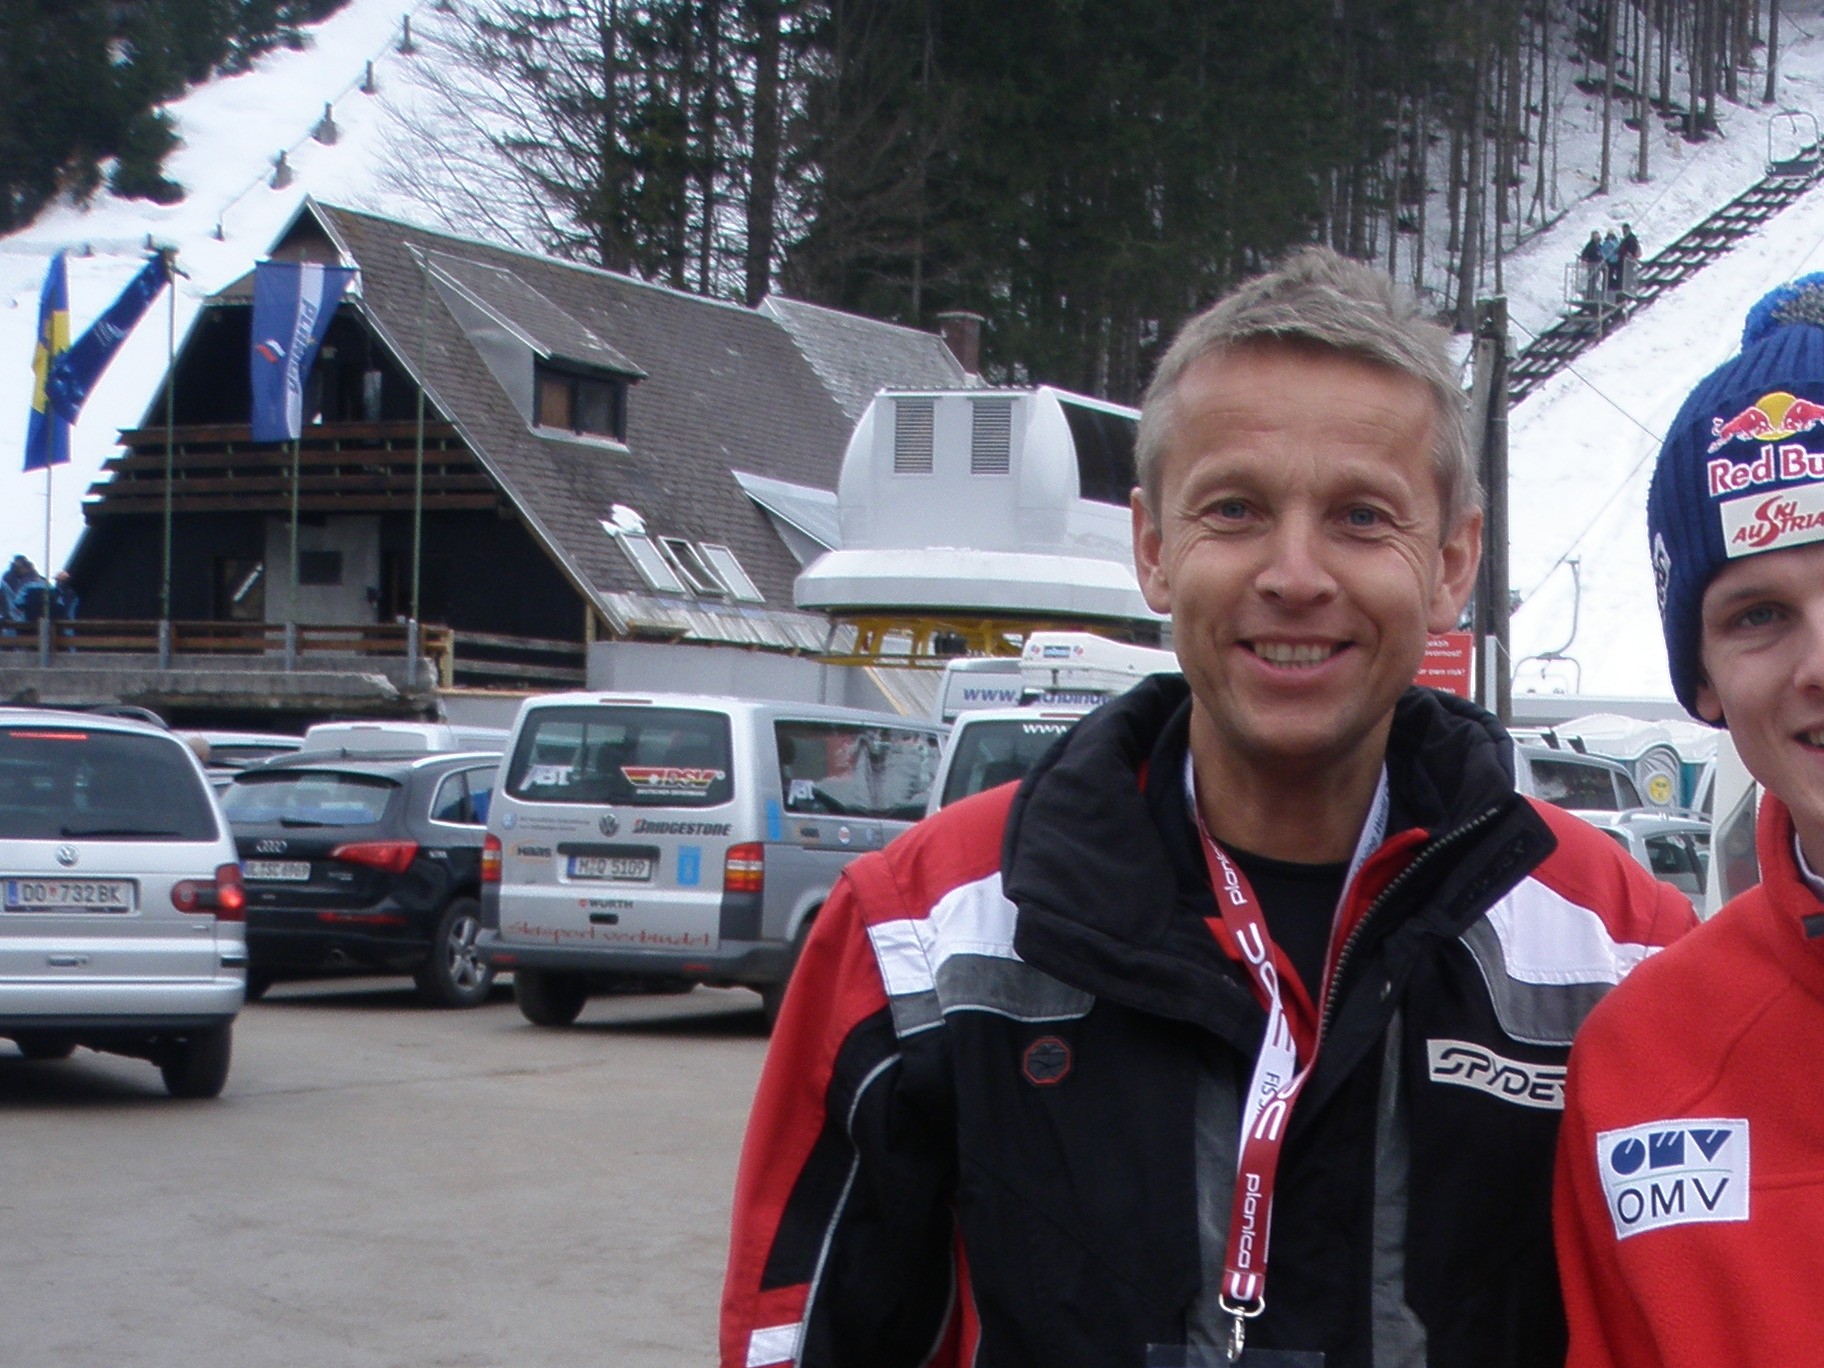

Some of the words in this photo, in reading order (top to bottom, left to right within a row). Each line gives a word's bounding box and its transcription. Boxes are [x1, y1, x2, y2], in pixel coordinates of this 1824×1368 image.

[1708, 444, 1774, 497] Red
[633, 818, 732, 836] BRIDGESTONE
[1433, 1047, 1565, 1101] SPYDE
[1617, 1177, 1730, 1225] OMV
